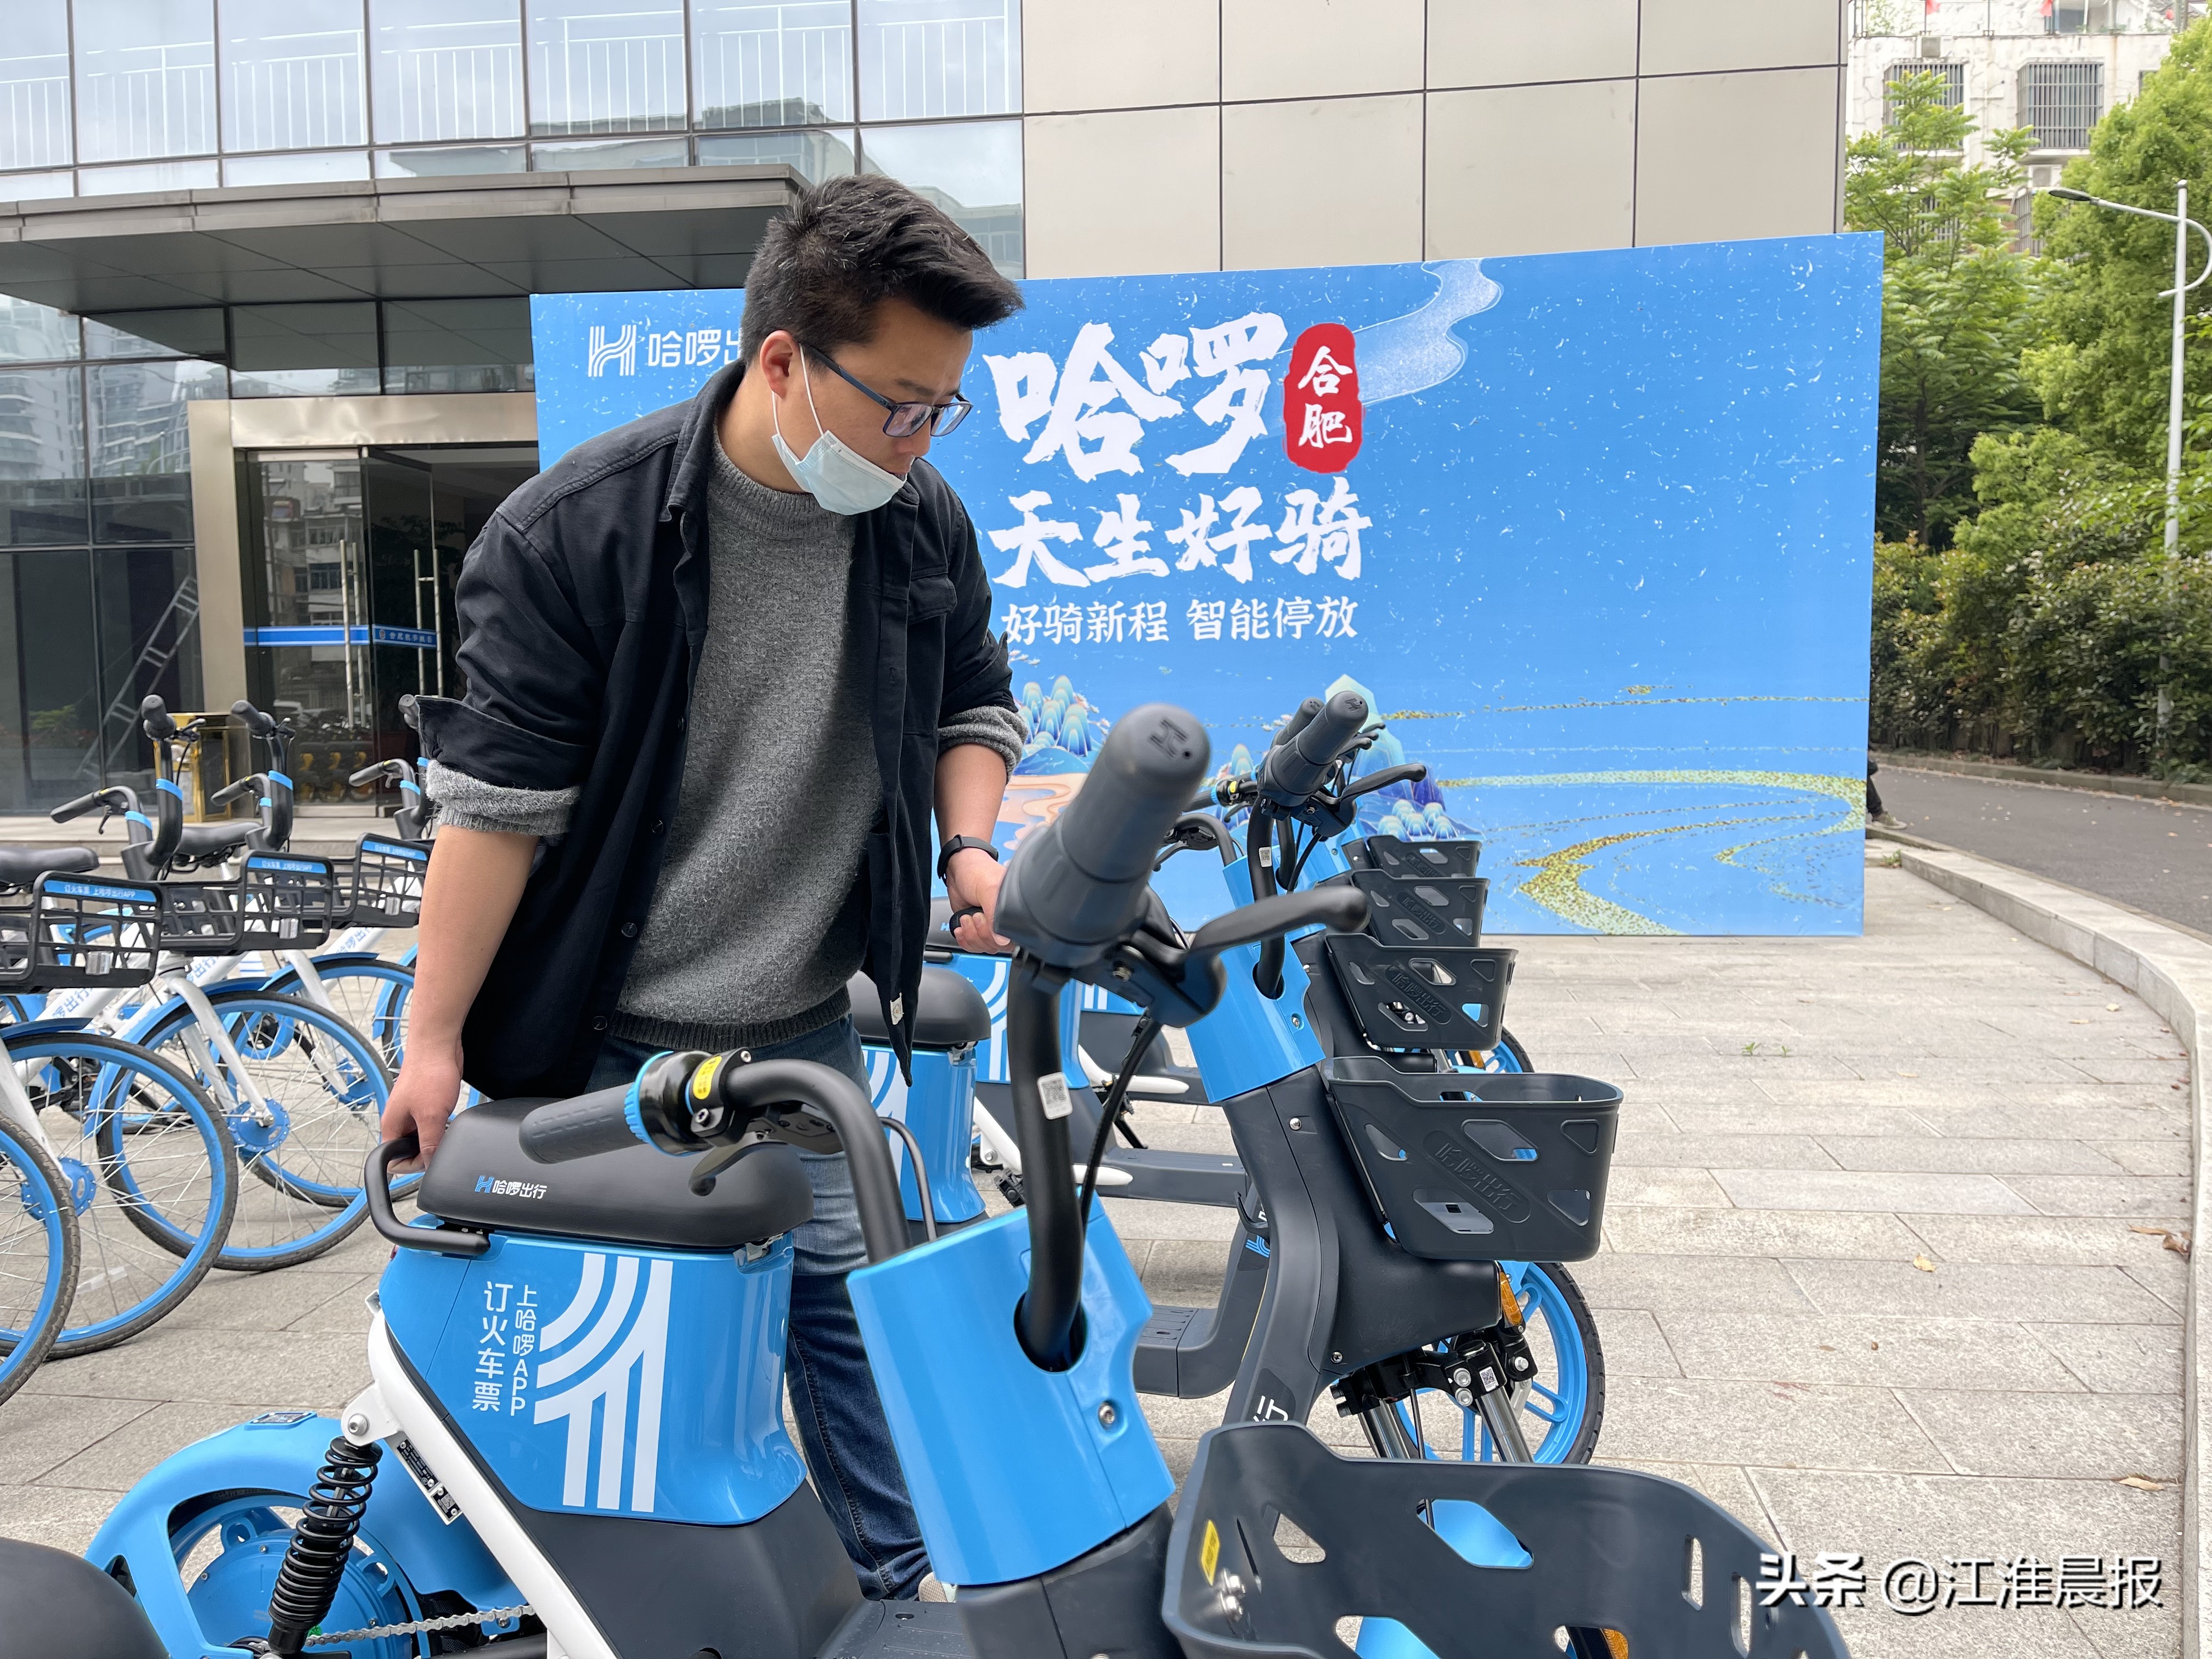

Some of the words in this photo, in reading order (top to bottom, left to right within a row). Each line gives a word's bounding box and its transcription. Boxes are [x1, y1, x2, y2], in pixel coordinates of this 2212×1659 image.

[983, 312, 1288, 483] 哈啰
[1298, 346, 1353, 449] 合肥
[988, 476, 1373, 587] 天生好骑
[1002, 600, 1169, 643] 好骑新程
[1187, 596, 1358, 641] 智能停放
[492, 1180, 548, 1200] 哈啰出行
[1435, 1142, 1521, 1210] 哈啰出行
[472, 1280, 514, 1412] 订火车票
[510, 1284, 538, 1417] 上哈啰APP
